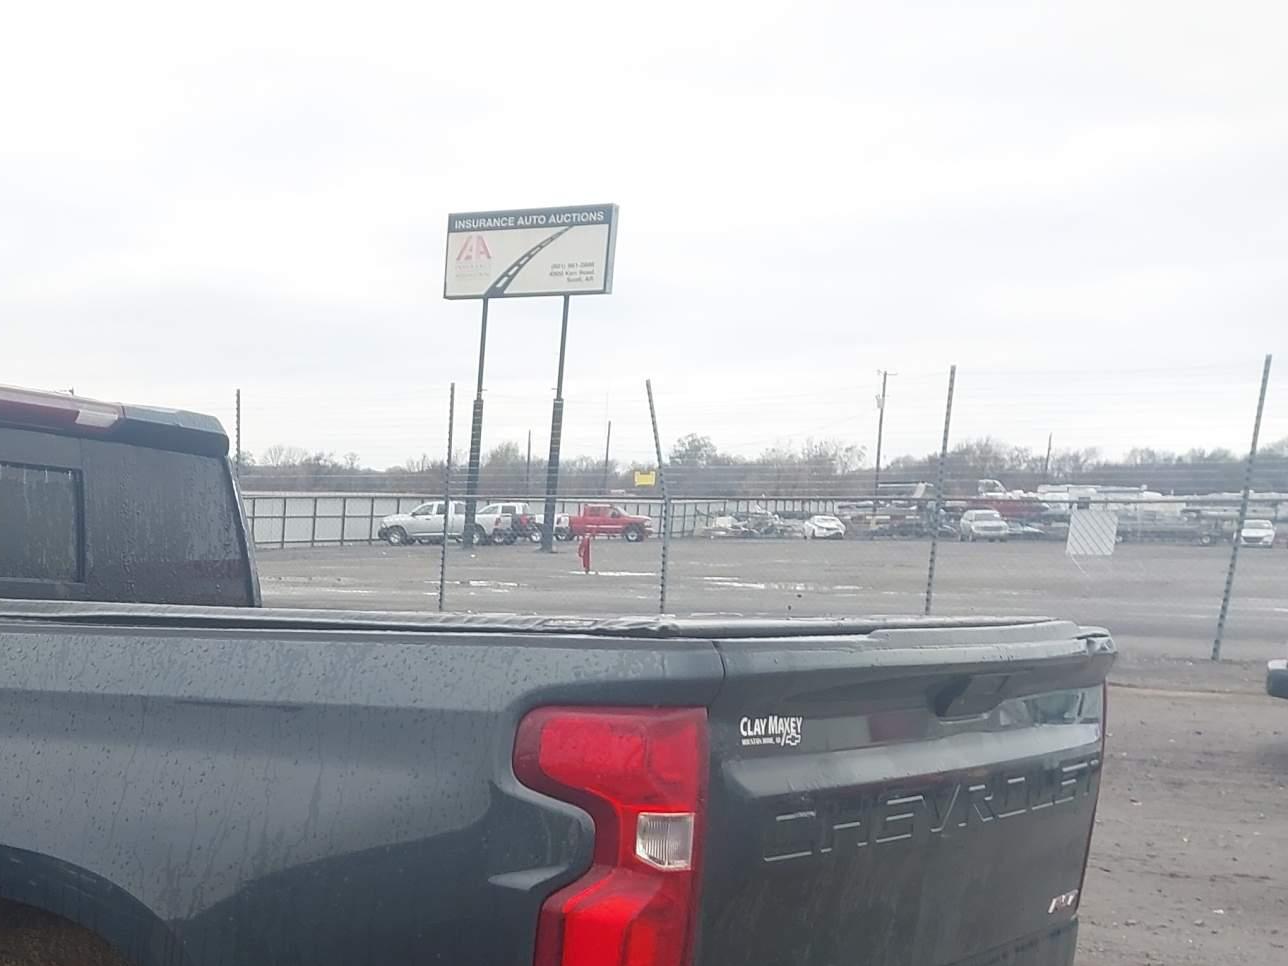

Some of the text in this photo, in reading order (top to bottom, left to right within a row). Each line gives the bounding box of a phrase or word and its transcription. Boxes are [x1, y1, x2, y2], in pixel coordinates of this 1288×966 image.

[455, 211, 605, 230] INSURANCE AUTO AUCTIONS
[740, 715, 803, 740] CLAY MAXEY
